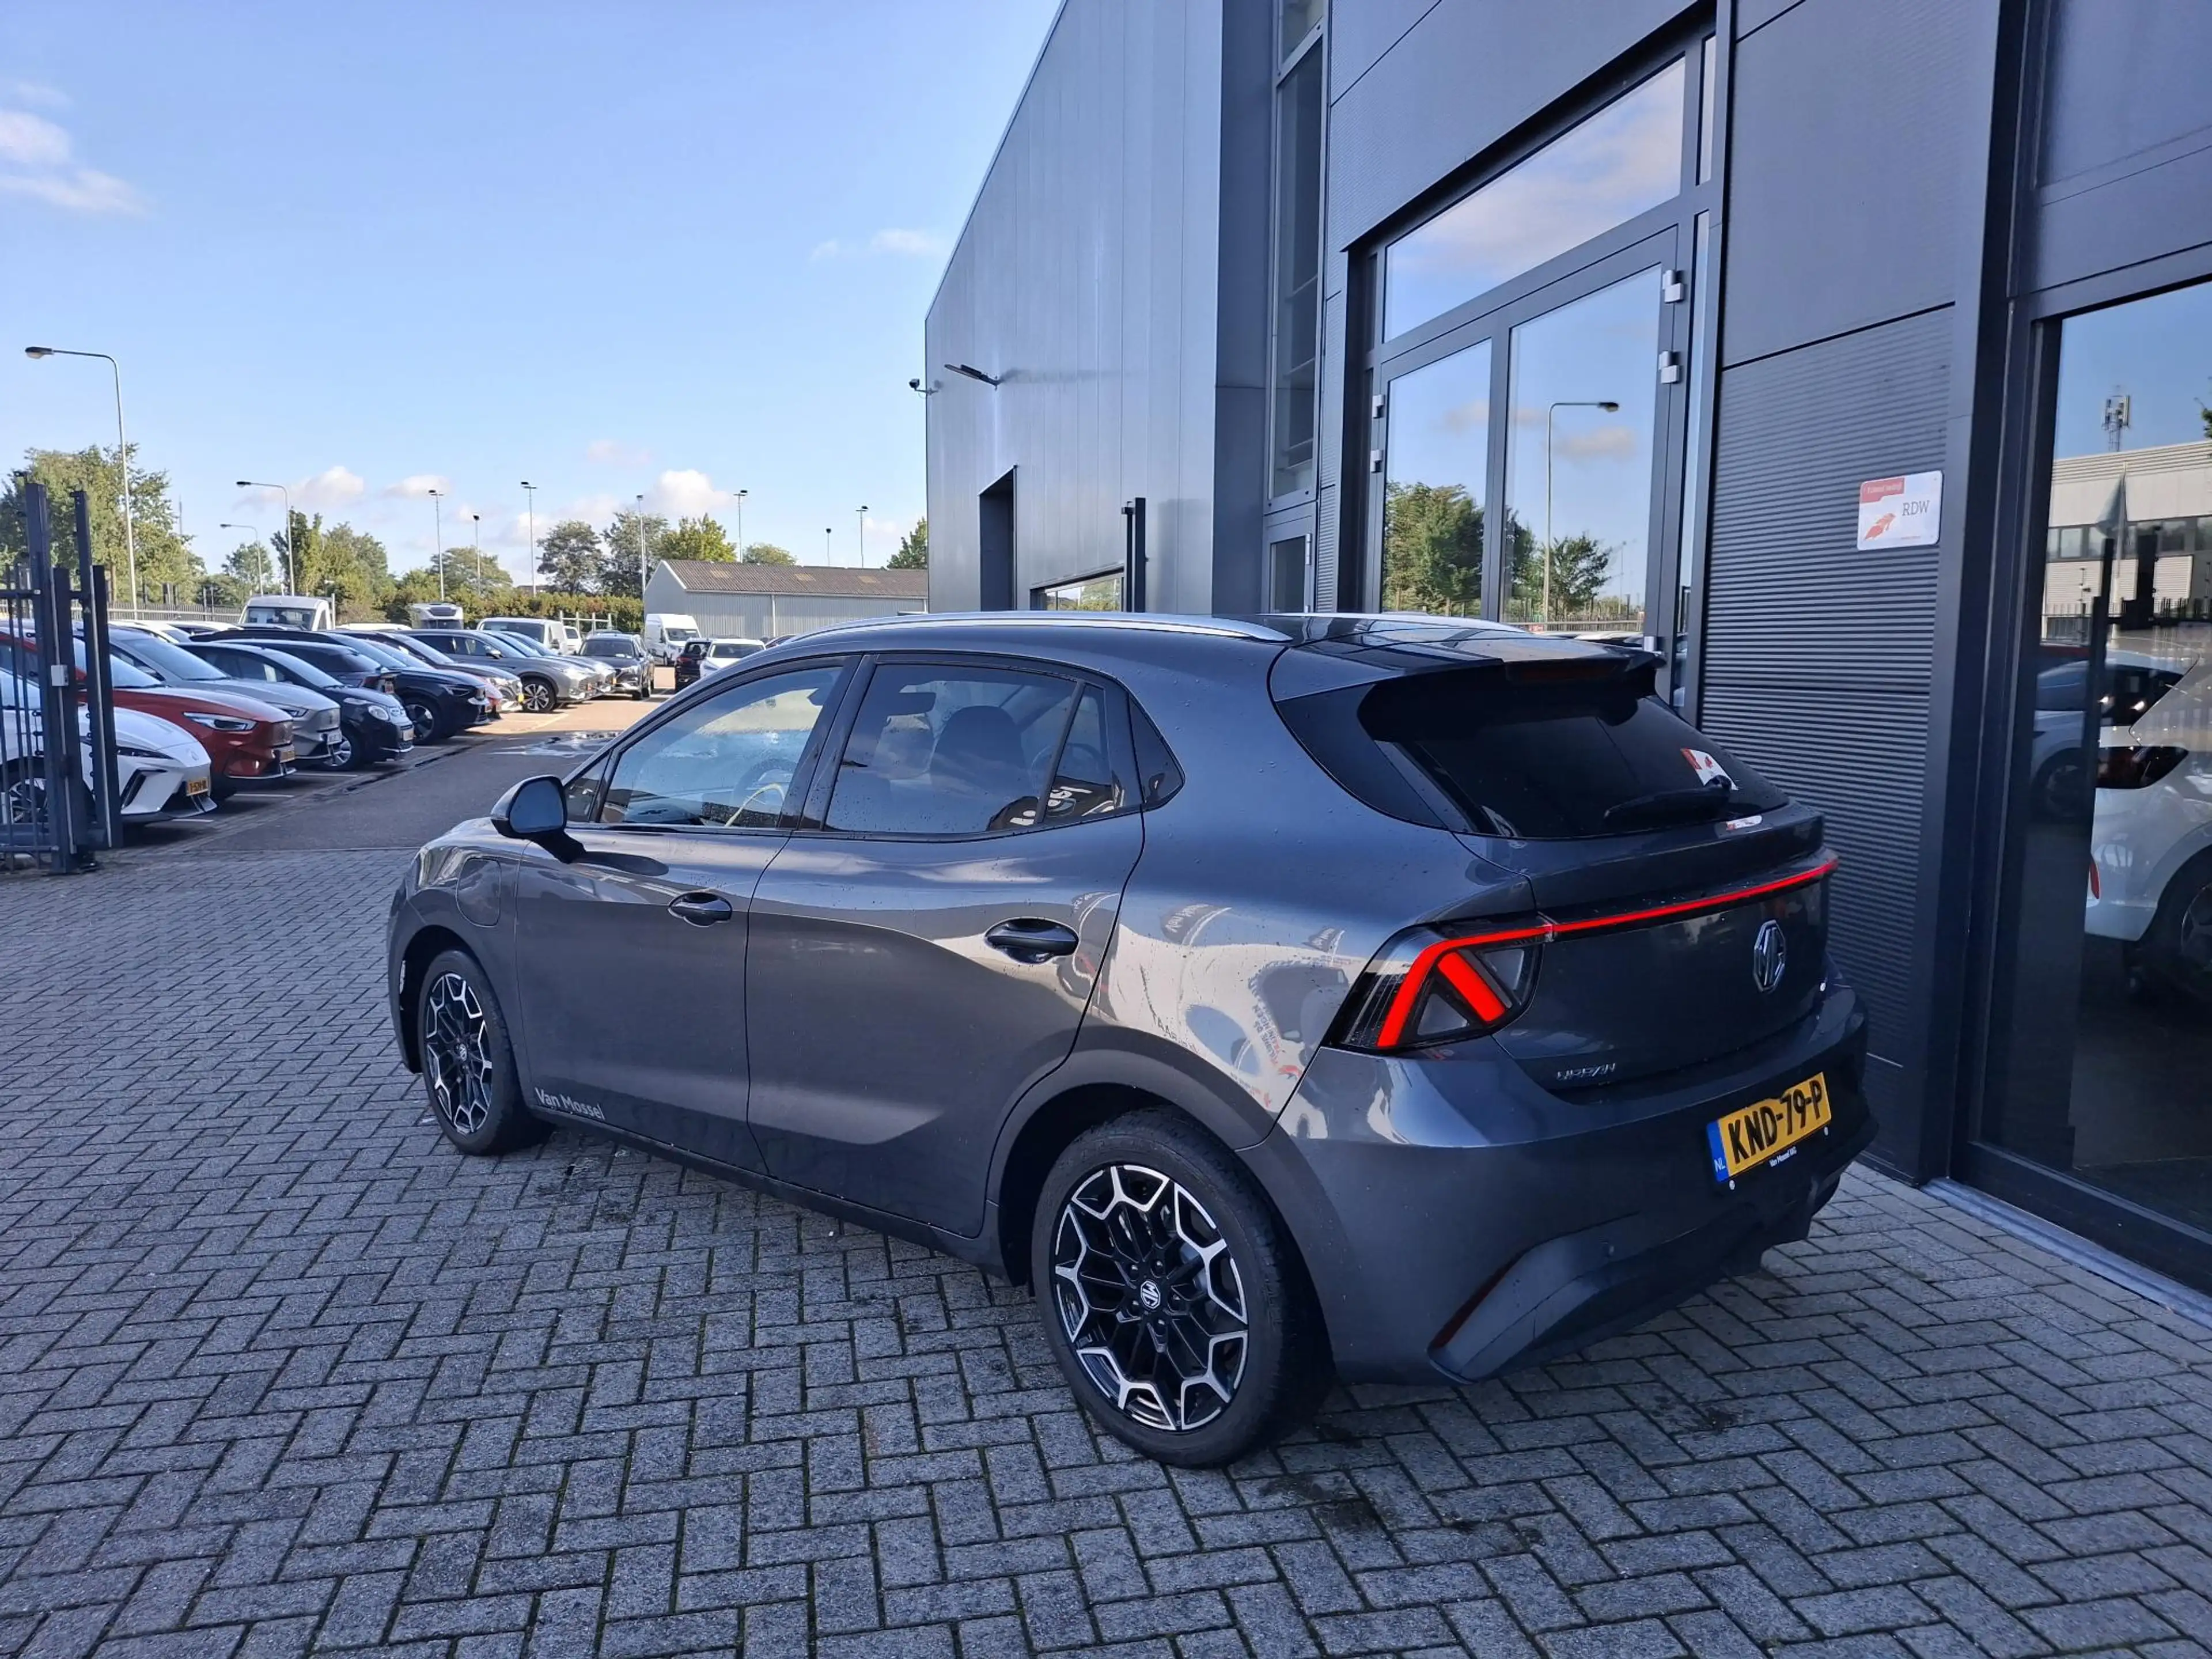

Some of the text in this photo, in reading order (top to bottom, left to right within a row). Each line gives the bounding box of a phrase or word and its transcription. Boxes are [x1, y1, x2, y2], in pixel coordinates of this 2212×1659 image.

[1902, 500, 1930, 516] RDW
[535, 1087, 605, 1120] Van Mossel
[1728, 1080, 1823, 1164] KND-79-P
[1714, 1157, 1726, 1173] NL
[1142, 1282, 1159, 1307] MG
